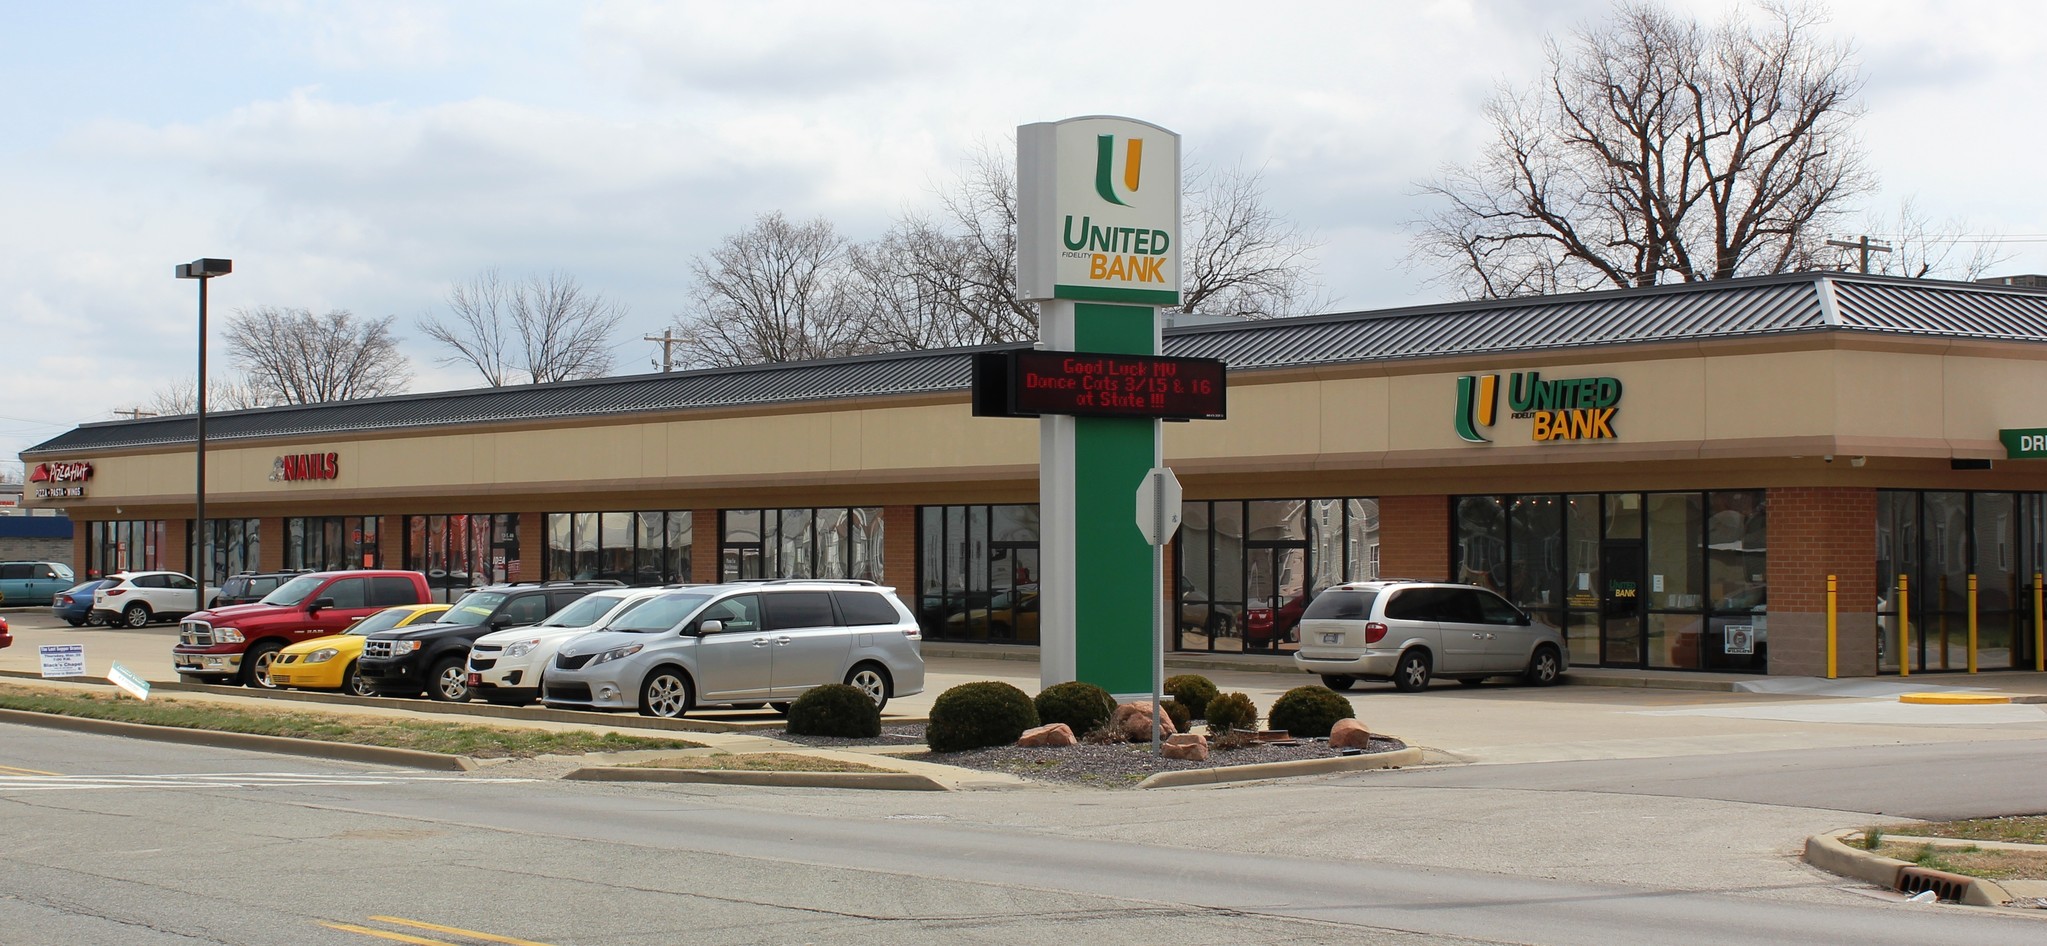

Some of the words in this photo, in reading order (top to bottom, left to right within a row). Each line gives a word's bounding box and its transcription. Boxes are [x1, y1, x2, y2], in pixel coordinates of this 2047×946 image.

[1063, 215, 1170, 255] UNITED
[1061, 251, 1092, 259] FIDELITY
[1090, 253, 1167, 283] BANK
[1063, 358, 1101, 374] Good
[1109, 360, 1147, 376] Luck
[1153, 362, 1177, 378] MV
[1026, 373, 1076, 389] Dance
[1083, 375, 1119, 391] Cats
[1125, 377, 1168, 393] 3/15
[1173, 380, 1184, 394] &
[1191, 380, 1211, 395] 16
[1508, 372, 1622, 412] UNITED
[1076, 392, 1094, 407] at
[1100, 391, 1145, 408] State
[1532, 407, 1618, 441] BANK
[48, 463, 71, 483] Pizza
[70, 463, 89, 482] Hut
[283, 452, 338, 481] NAILS
[35, 489, 48, 497] PIZZA
[51, 488, 64, 497] PASTA
[67, 487, 81, 497] WINGS
[1615, 589, 1637, 597] BANK
